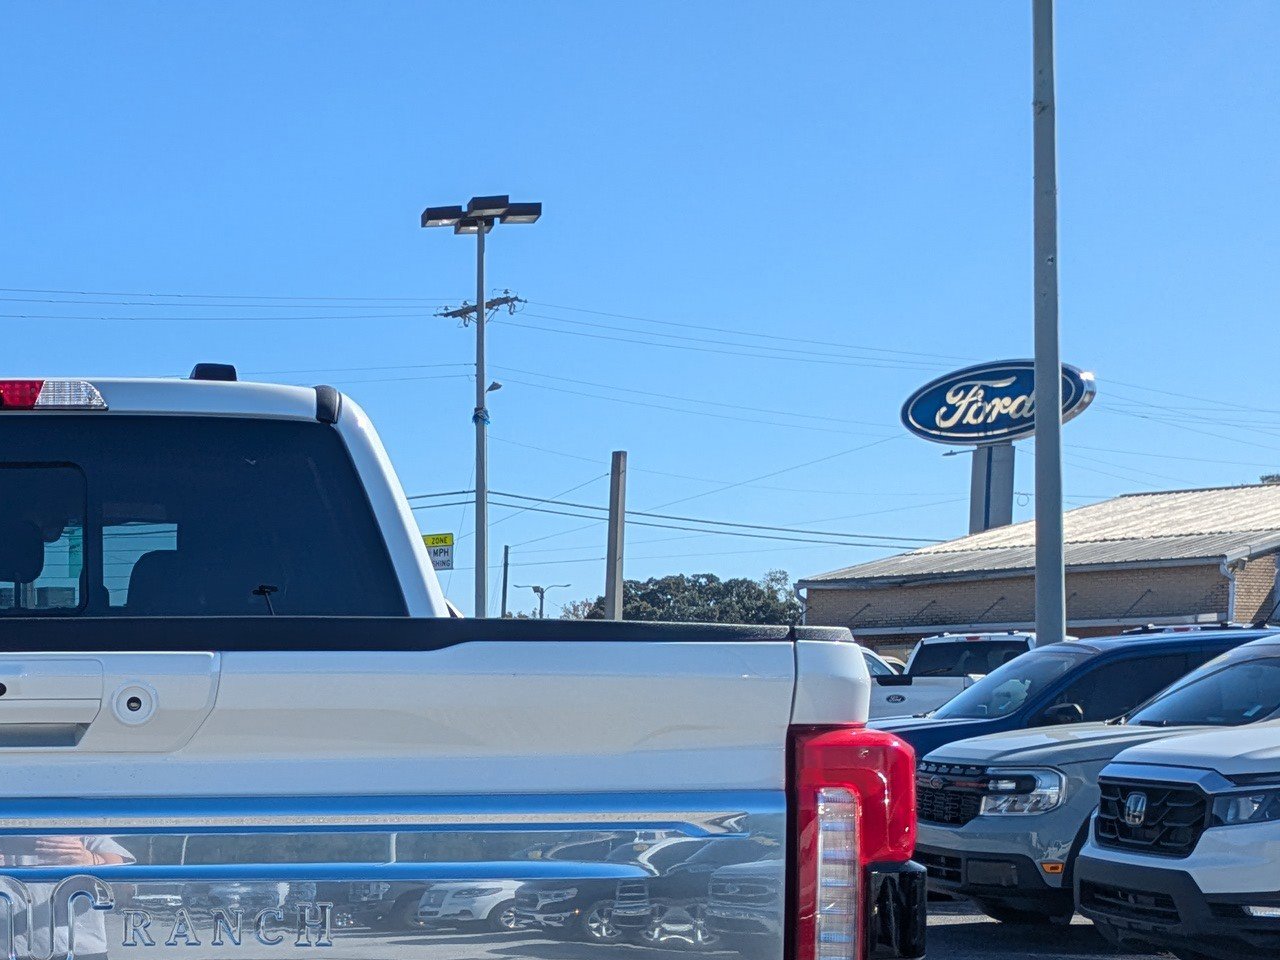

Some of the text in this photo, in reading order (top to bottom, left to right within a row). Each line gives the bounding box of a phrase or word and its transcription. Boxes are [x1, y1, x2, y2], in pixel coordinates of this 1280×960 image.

[431, 536, 448, 545] ZONE
[432, 548, 449, 557] MPH
[432, 559, 451, 567] SHING
[121, 901, 333, 948] RANCH
